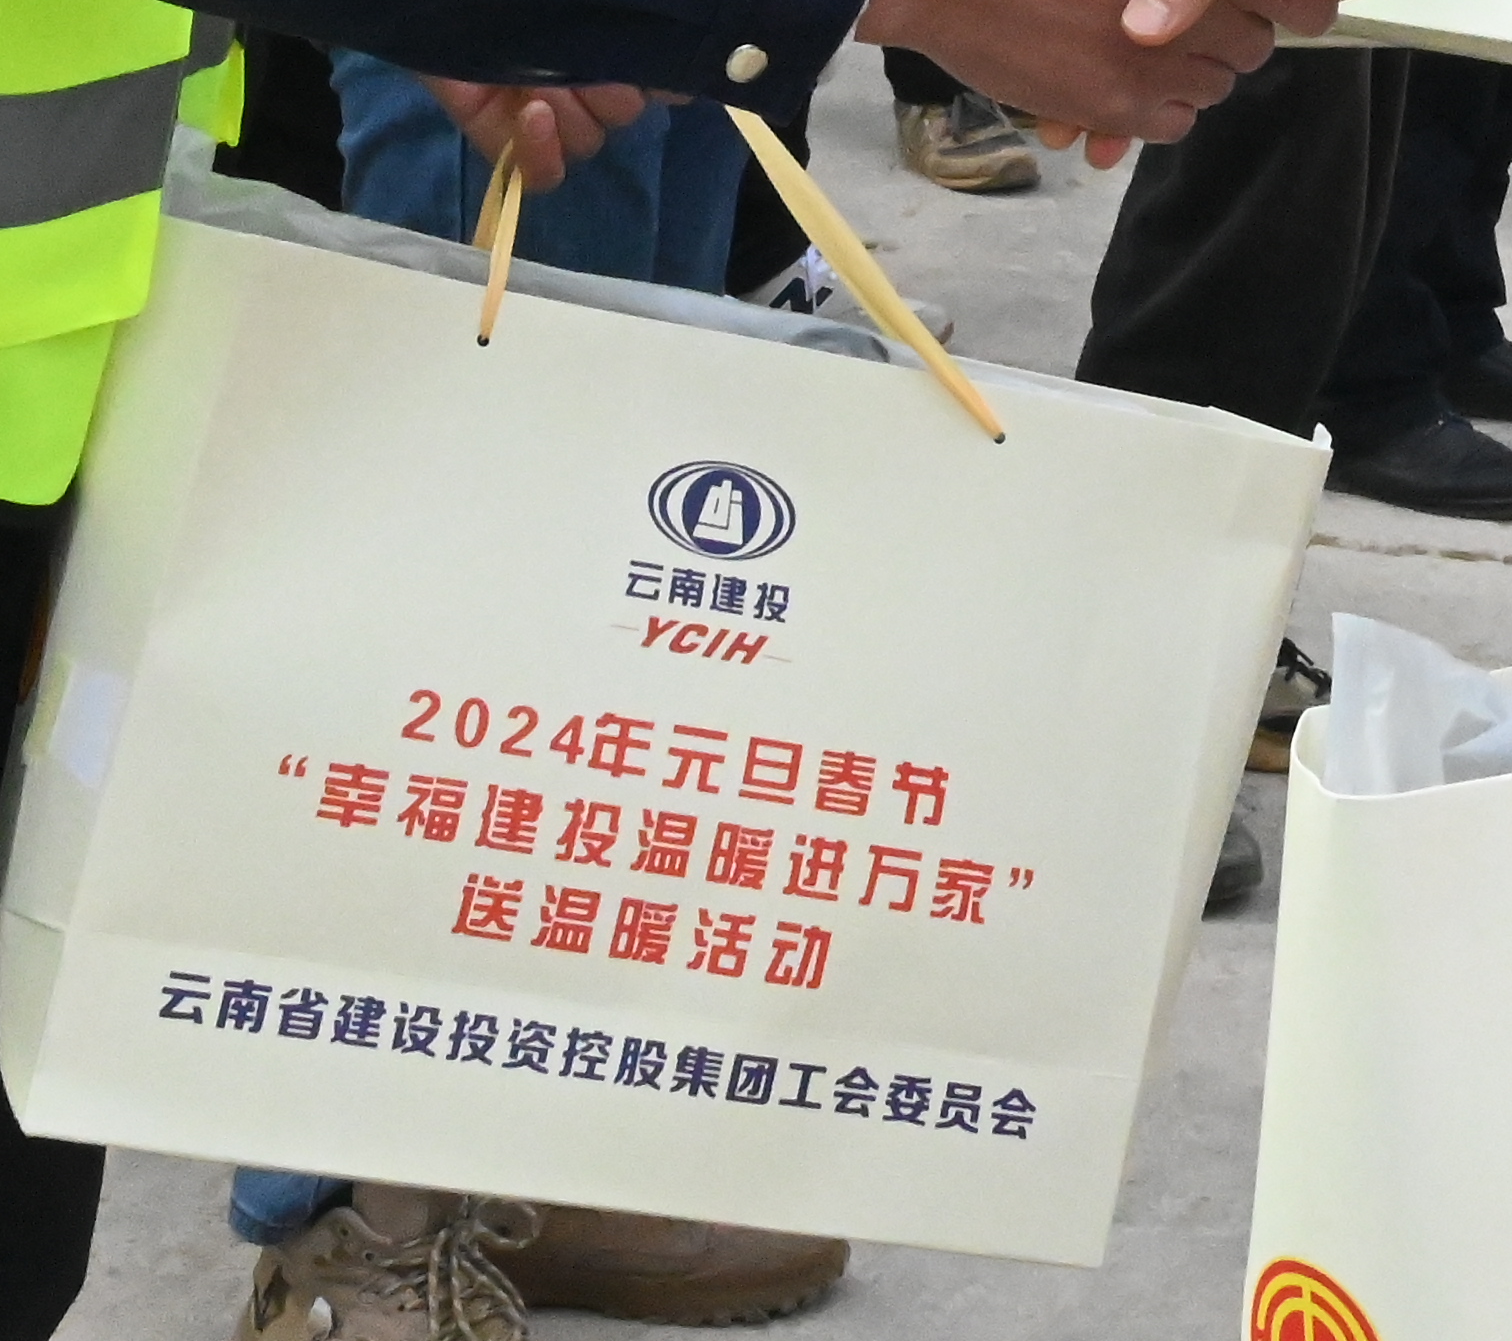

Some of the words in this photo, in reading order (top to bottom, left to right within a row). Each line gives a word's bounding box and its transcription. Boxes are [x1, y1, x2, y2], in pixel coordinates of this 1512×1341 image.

[626, 560, 791, 624] 云南建投
[639, 616, 770, 667] YCIH
[400, 688, 949, 828] 2024年元旦春节
[278, 753, 1035, 926] “幸福建投温暖进万家”
[451, 873, 834, 990] 送温暖活动
[158, 969, 1039, 1140] 云南省建设投资控股集团工会委员会
